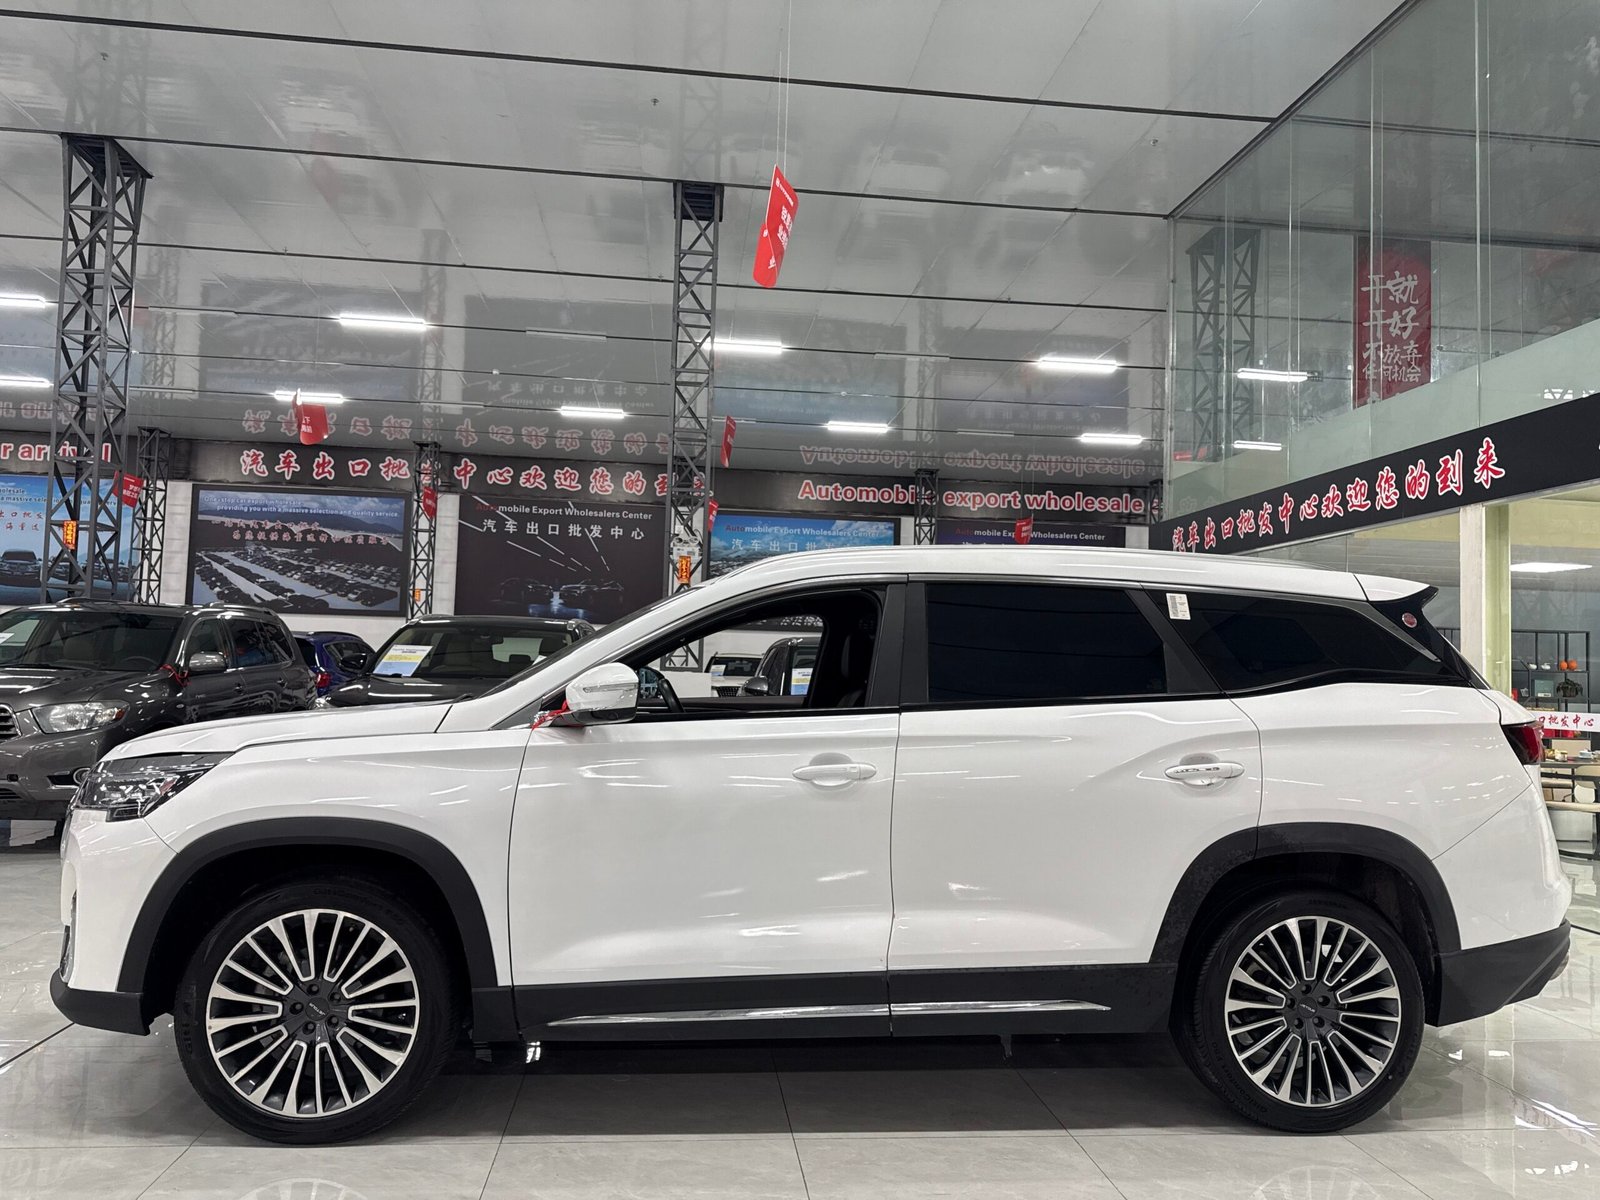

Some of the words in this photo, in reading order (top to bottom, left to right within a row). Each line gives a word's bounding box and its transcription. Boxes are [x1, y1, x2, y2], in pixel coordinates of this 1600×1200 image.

[1362, 307, 1419, 340] 干好
[1362, 340, 1422, 365] 不放弃
[1362, 363, 1422, 383] 任何机会
[943, 490, 1021, 511] export
[1024, 491, 1145, 513] wholesale
[1172, 436, 1505, 552] 汽车出口批发中心欢迎您的到来
[216, 504, 247, 512] providing
[352, 509, 374, 517] quality
[532, 506, 563, 516] Export
[565, 507, 620, 518] Wholesalers
[622, 511, 652, 520] Center
[482, 519, 645, 540] 汽车出口批发中心
[726, 525, 771, 534] Automobile
[774, 526, 800, 536] Export
[802, 527, 851, 537] Wholesalers
[1030, 531, 1077, 540] Wholesalers
[1079, 533, 1105, 541] Center
